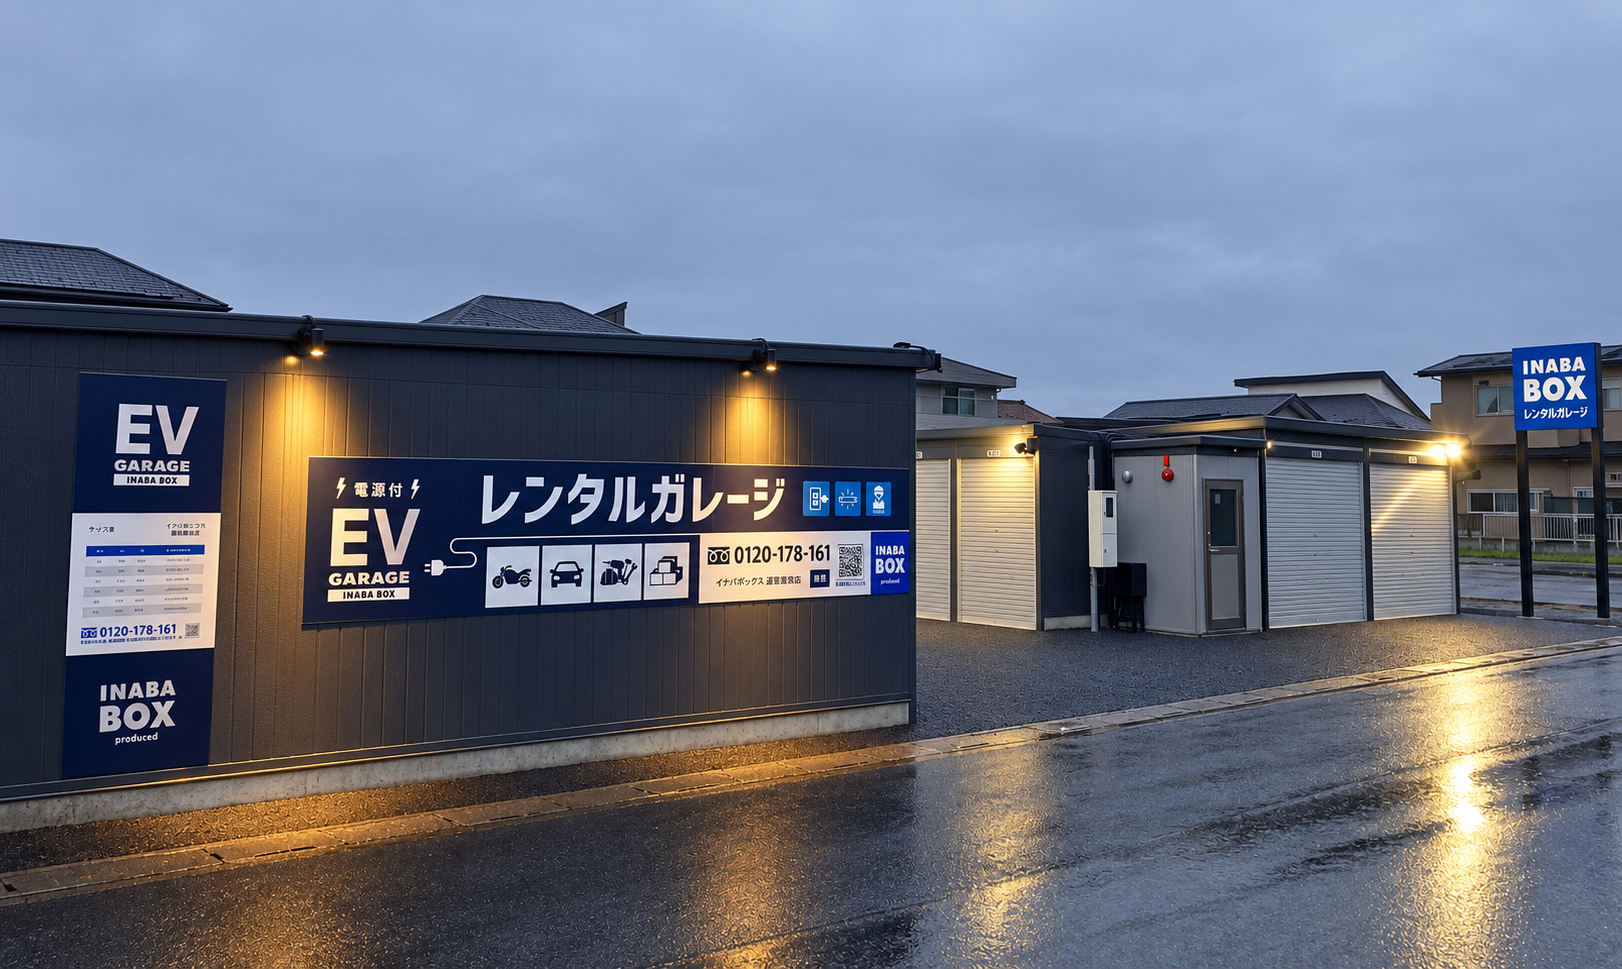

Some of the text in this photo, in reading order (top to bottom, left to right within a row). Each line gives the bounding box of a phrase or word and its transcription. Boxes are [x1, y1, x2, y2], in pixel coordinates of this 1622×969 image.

[1522, 356, 1586, 376] INABA
[1523, 374, 1588, 403] BOX
[1524, 406, 1589, 420] レンタルガレージ
[115, 403, 200, 456] EV
[113, 459, 191, 473] GARAGE
[126, 475, 178, 485] INABA BOX
[353, 481, 403, 498] 電源付
[481, 473, 786, 525] レンタルガレージ
[329, 507, 421, 567] EV
[734, 544, 831, 565] 0120-178-161
[875, 545, 906, 556] INABA
[875, 557, 906, 575] BOX
[328, 571, 410, 586] GARAGE
[715, 576, 765, 587] イナバボックス
[342, 590, 396, 600] INABA BOX
[99, 623, 177, 639] 0120-178-161
[100, 679, 177, 702] INABA
[98, 700, 176, 733] BOX
[114, 731, 159, 746] produced
